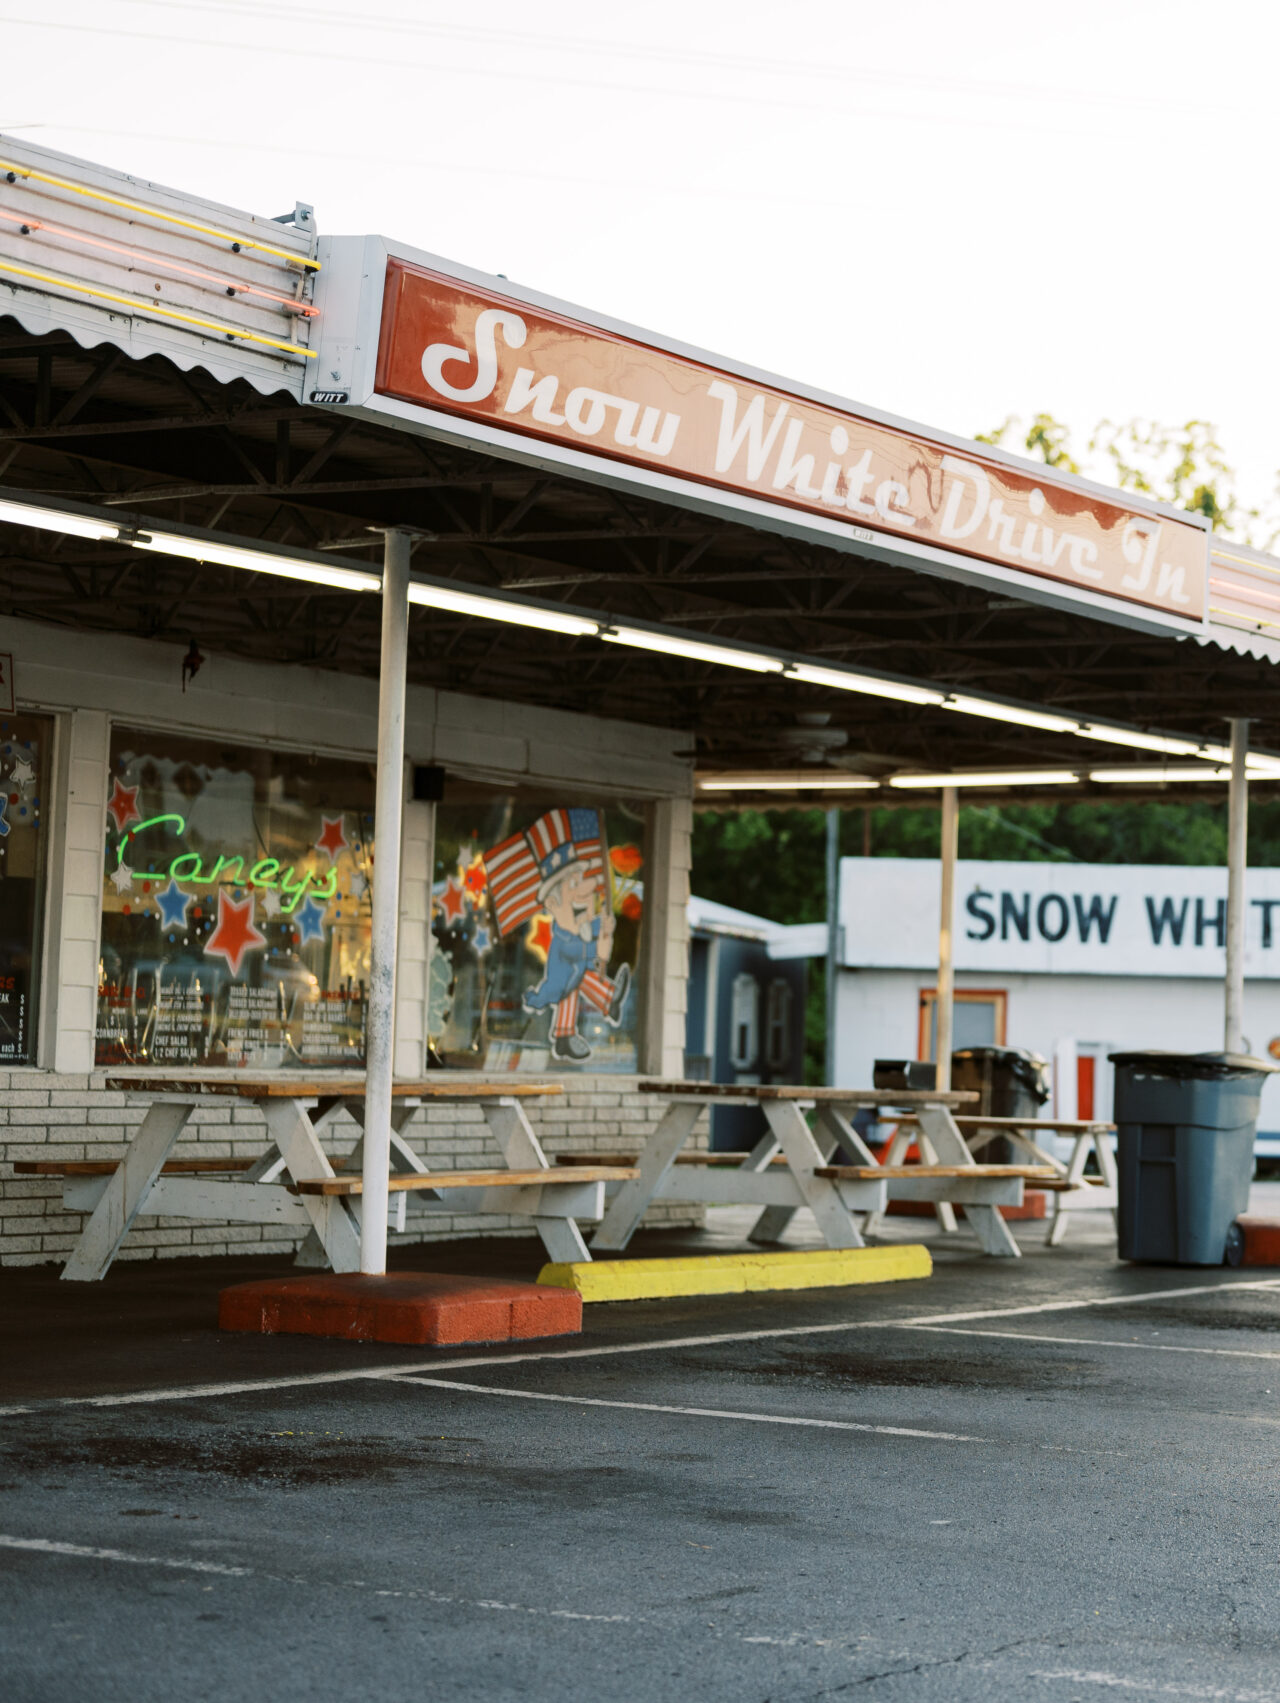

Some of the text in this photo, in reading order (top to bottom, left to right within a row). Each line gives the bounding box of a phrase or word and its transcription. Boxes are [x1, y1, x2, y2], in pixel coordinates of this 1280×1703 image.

[313, 392, 345, 403] WITT
[421, 309, 1190, 603] Snow White Drive In
[966, 891, 1118, 944] SNOW
